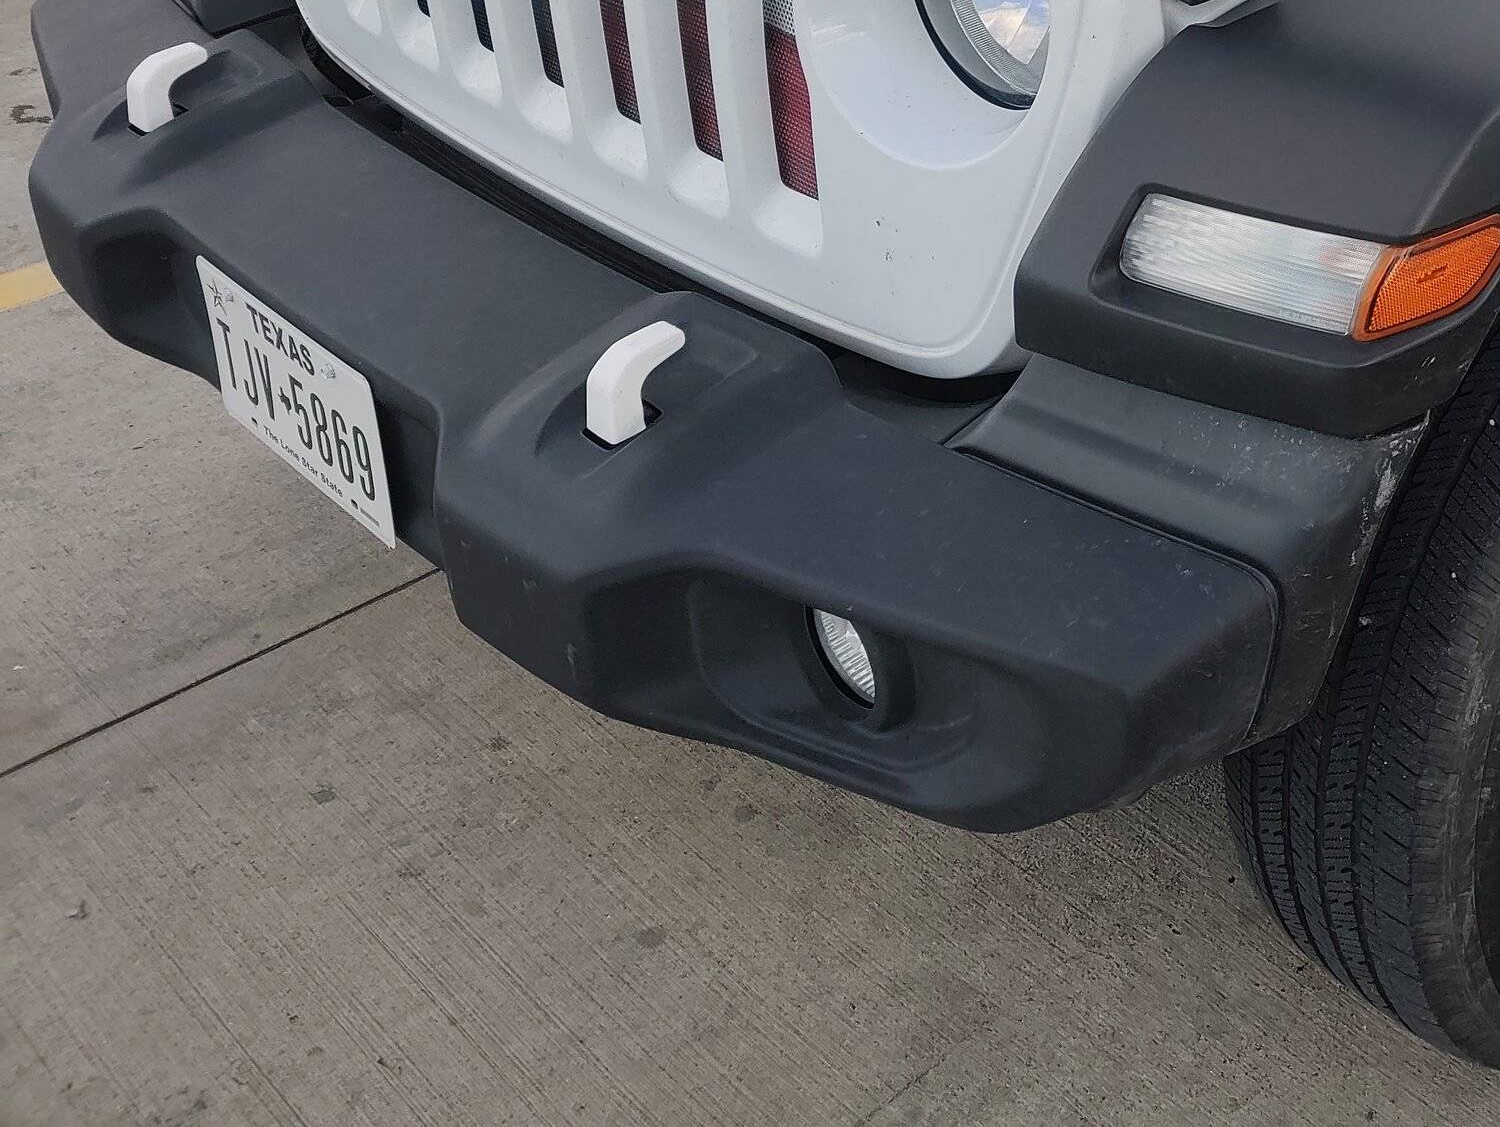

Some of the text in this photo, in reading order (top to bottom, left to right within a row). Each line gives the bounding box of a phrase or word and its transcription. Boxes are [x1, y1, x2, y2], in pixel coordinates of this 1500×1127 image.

[245, 301, 315, 376] TEXAS
[263, 425, 344, 498] The Lone Star State
